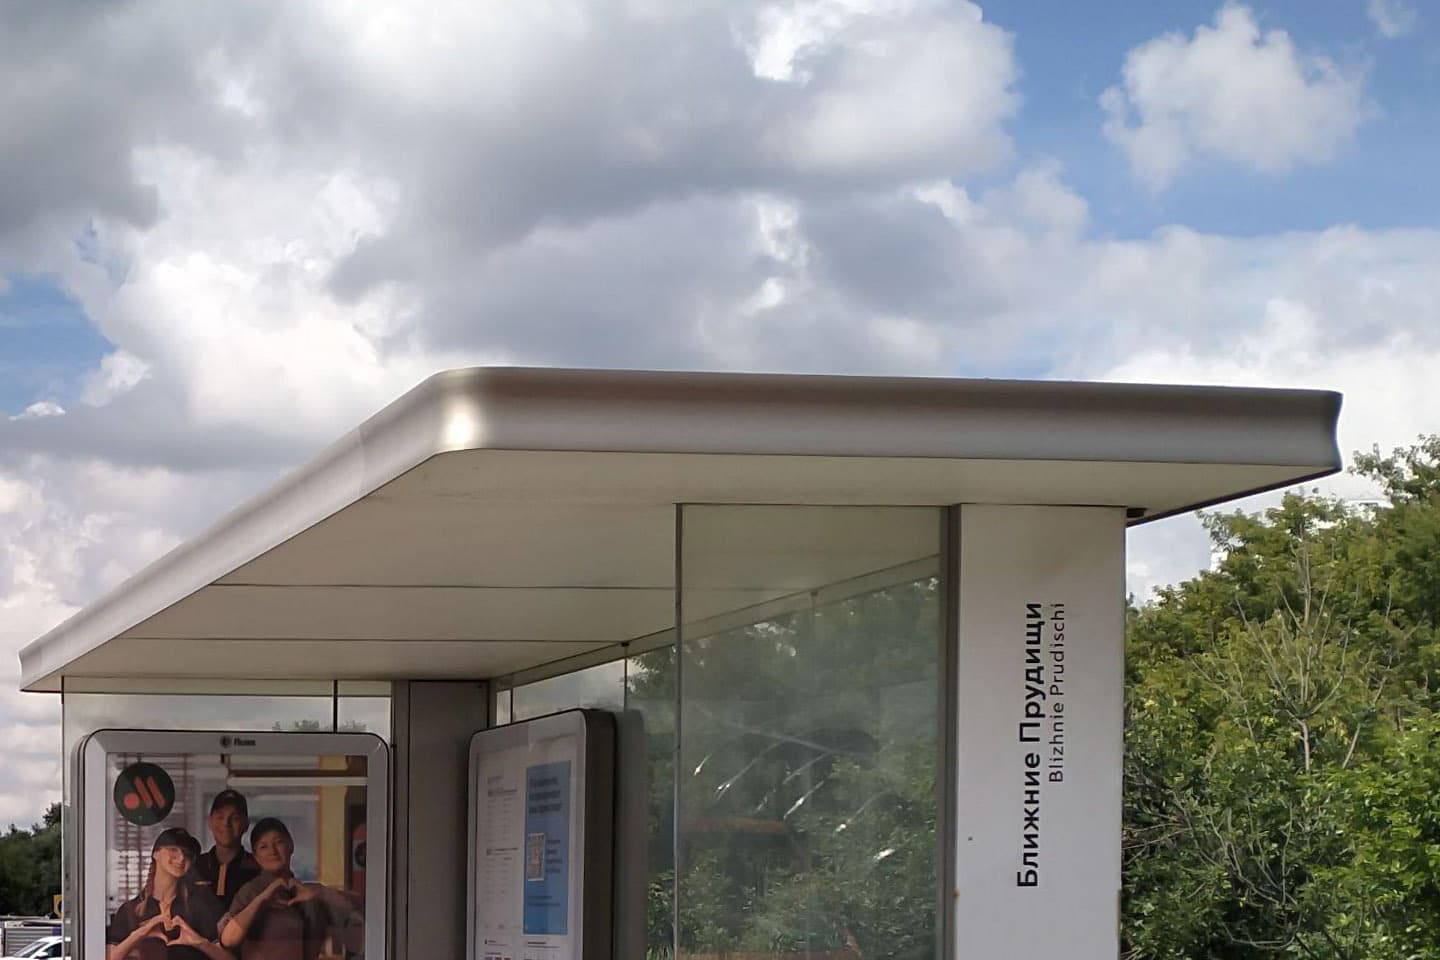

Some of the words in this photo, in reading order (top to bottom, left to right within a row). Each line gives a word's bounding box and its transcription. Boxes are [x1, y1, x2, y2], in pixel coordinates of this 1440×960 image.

[1019, 603, 1046, 743] Прудищи
[1049, 603, 1065, 696] Prudischi
[1048, 702, 1064, 783] Blizhnie
[1017, 752, 1040, 888] Ближние
